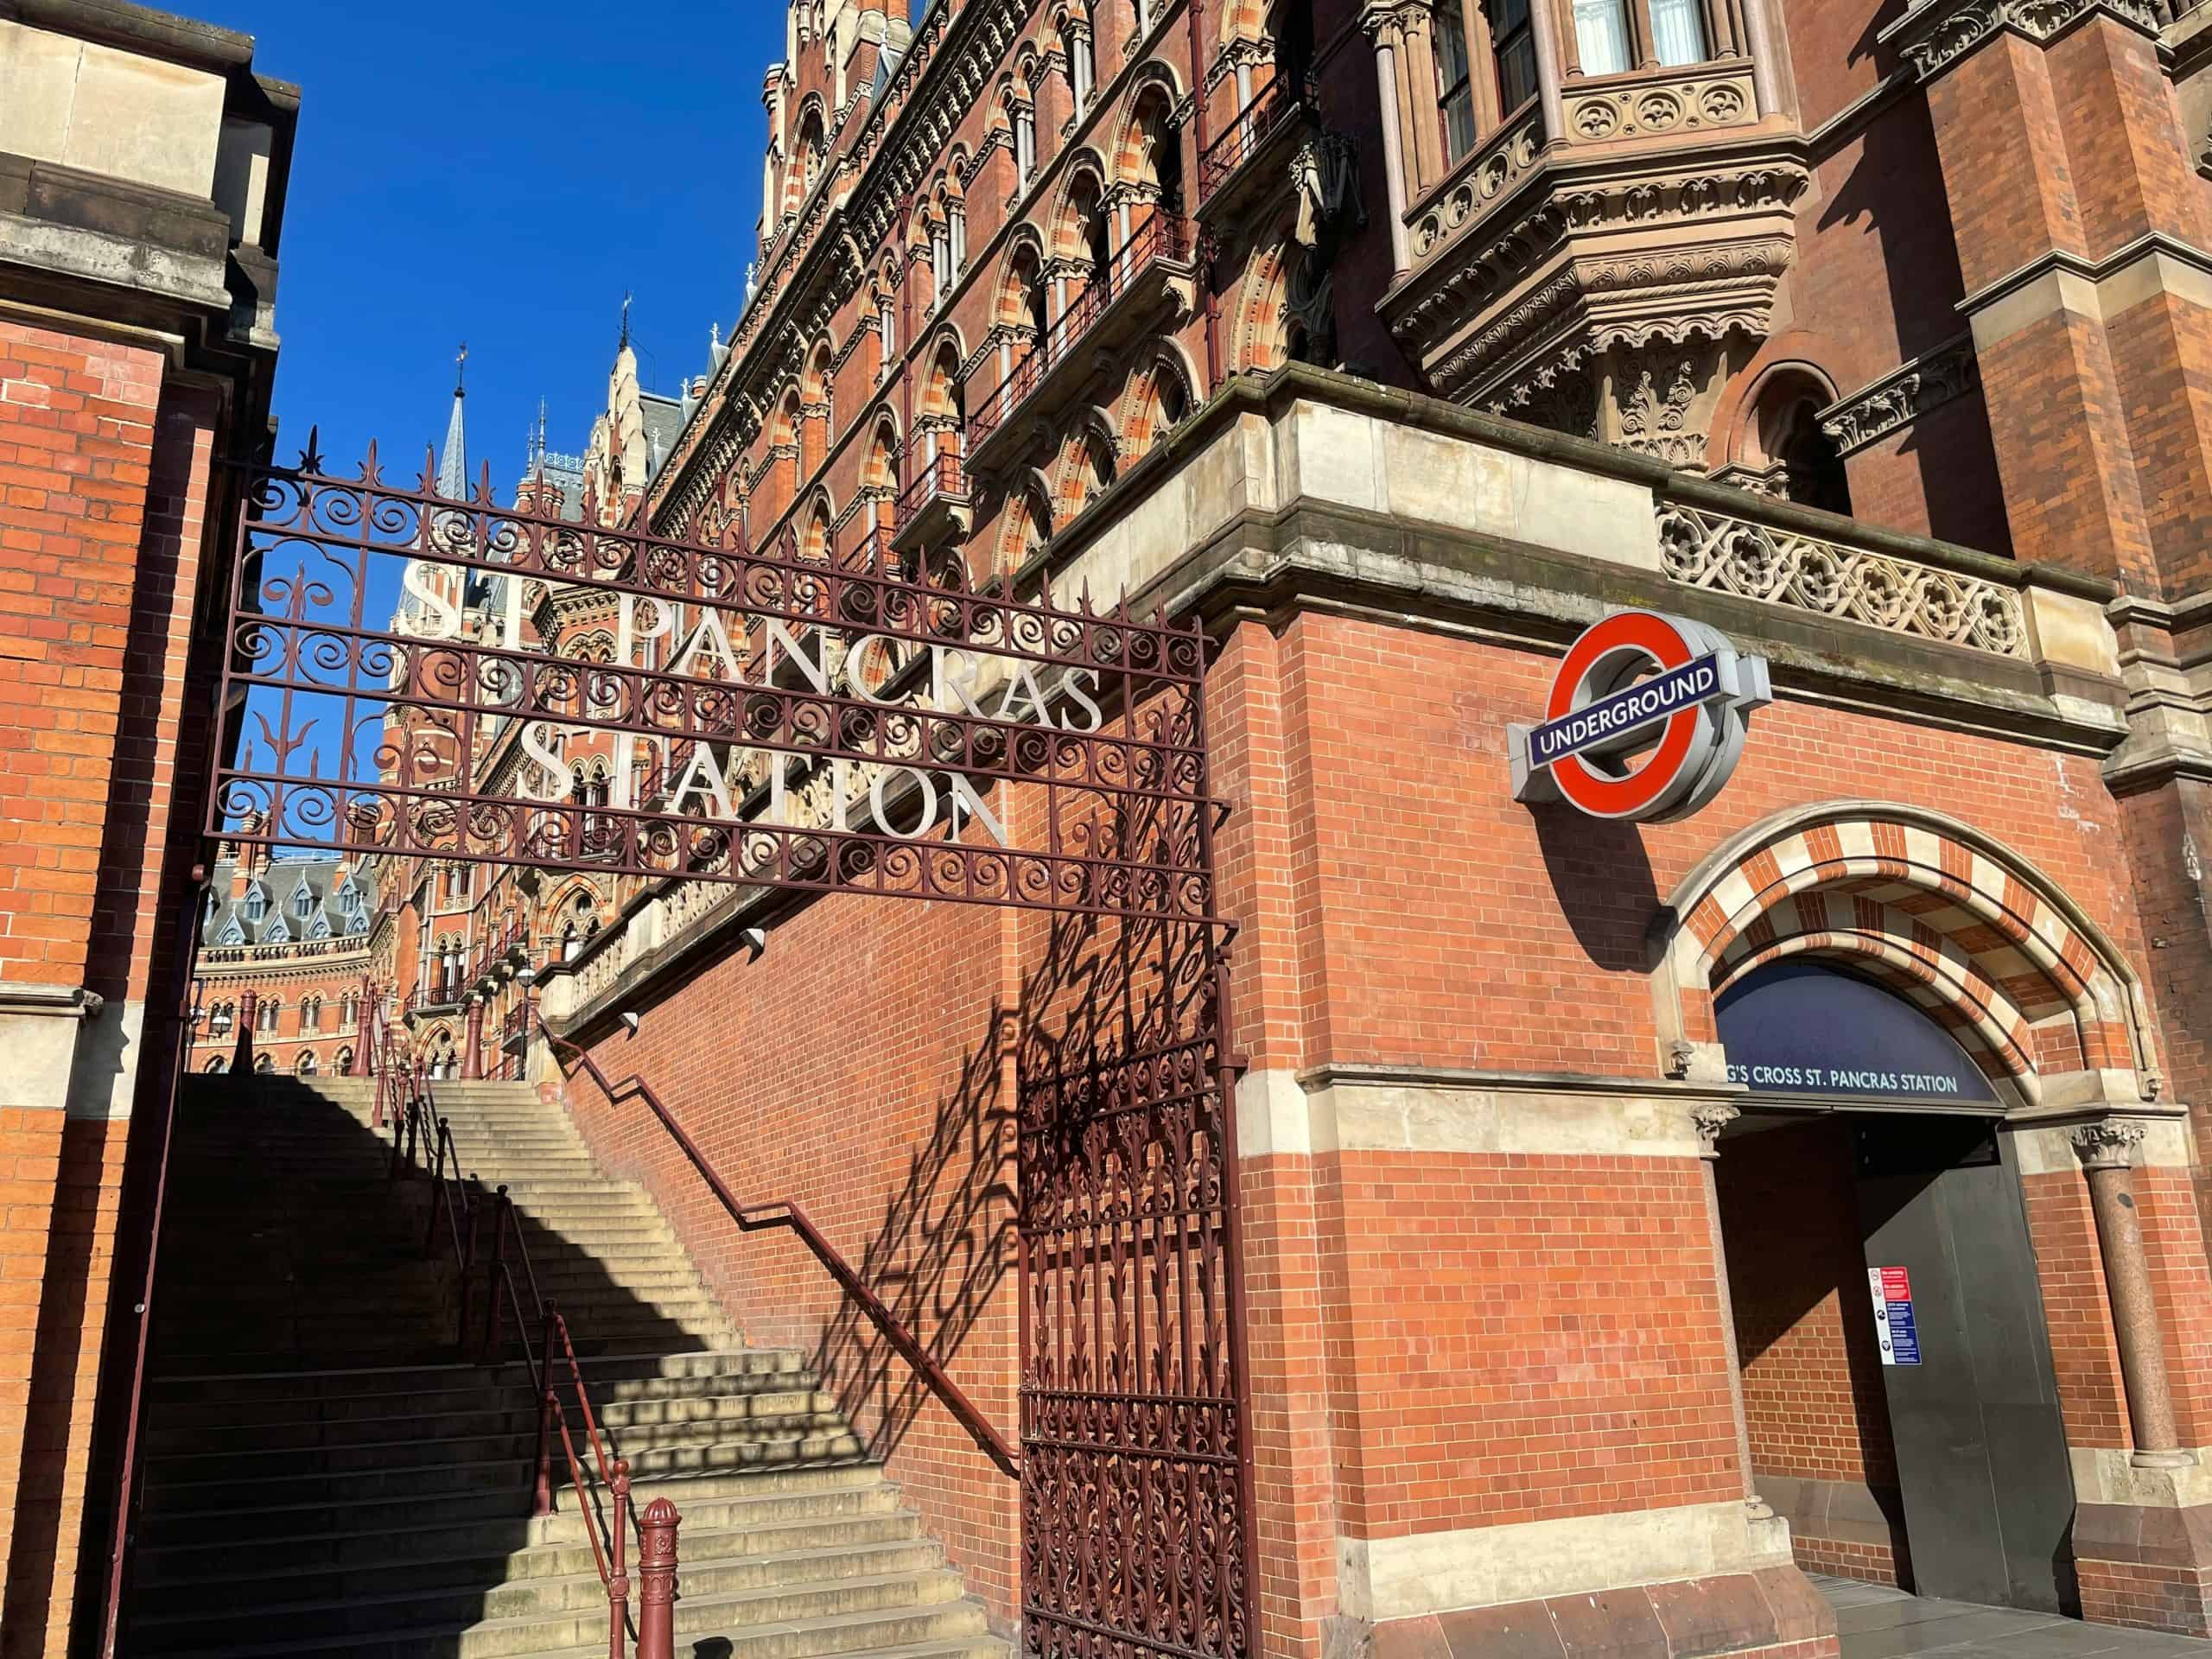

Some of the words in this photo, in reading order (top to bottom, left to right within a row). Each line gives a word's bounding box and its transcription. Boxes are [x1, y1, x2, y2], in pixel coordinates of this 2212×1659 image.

[397, 559, 553, 652] ST
[607, 588, 1103, 734] PANCRAS
[1540, 667, 1713, 754] UNDERGROUND
[516, 719, 1013, 848] STATION
[1752, 1065, 1802, 1086] CROSS
[1806, 1069, 1827, 1086] ST.
[1831, 1071, 1897, 1090] PANCRAS
[1901, 1073, 1957, 1093] STATION
